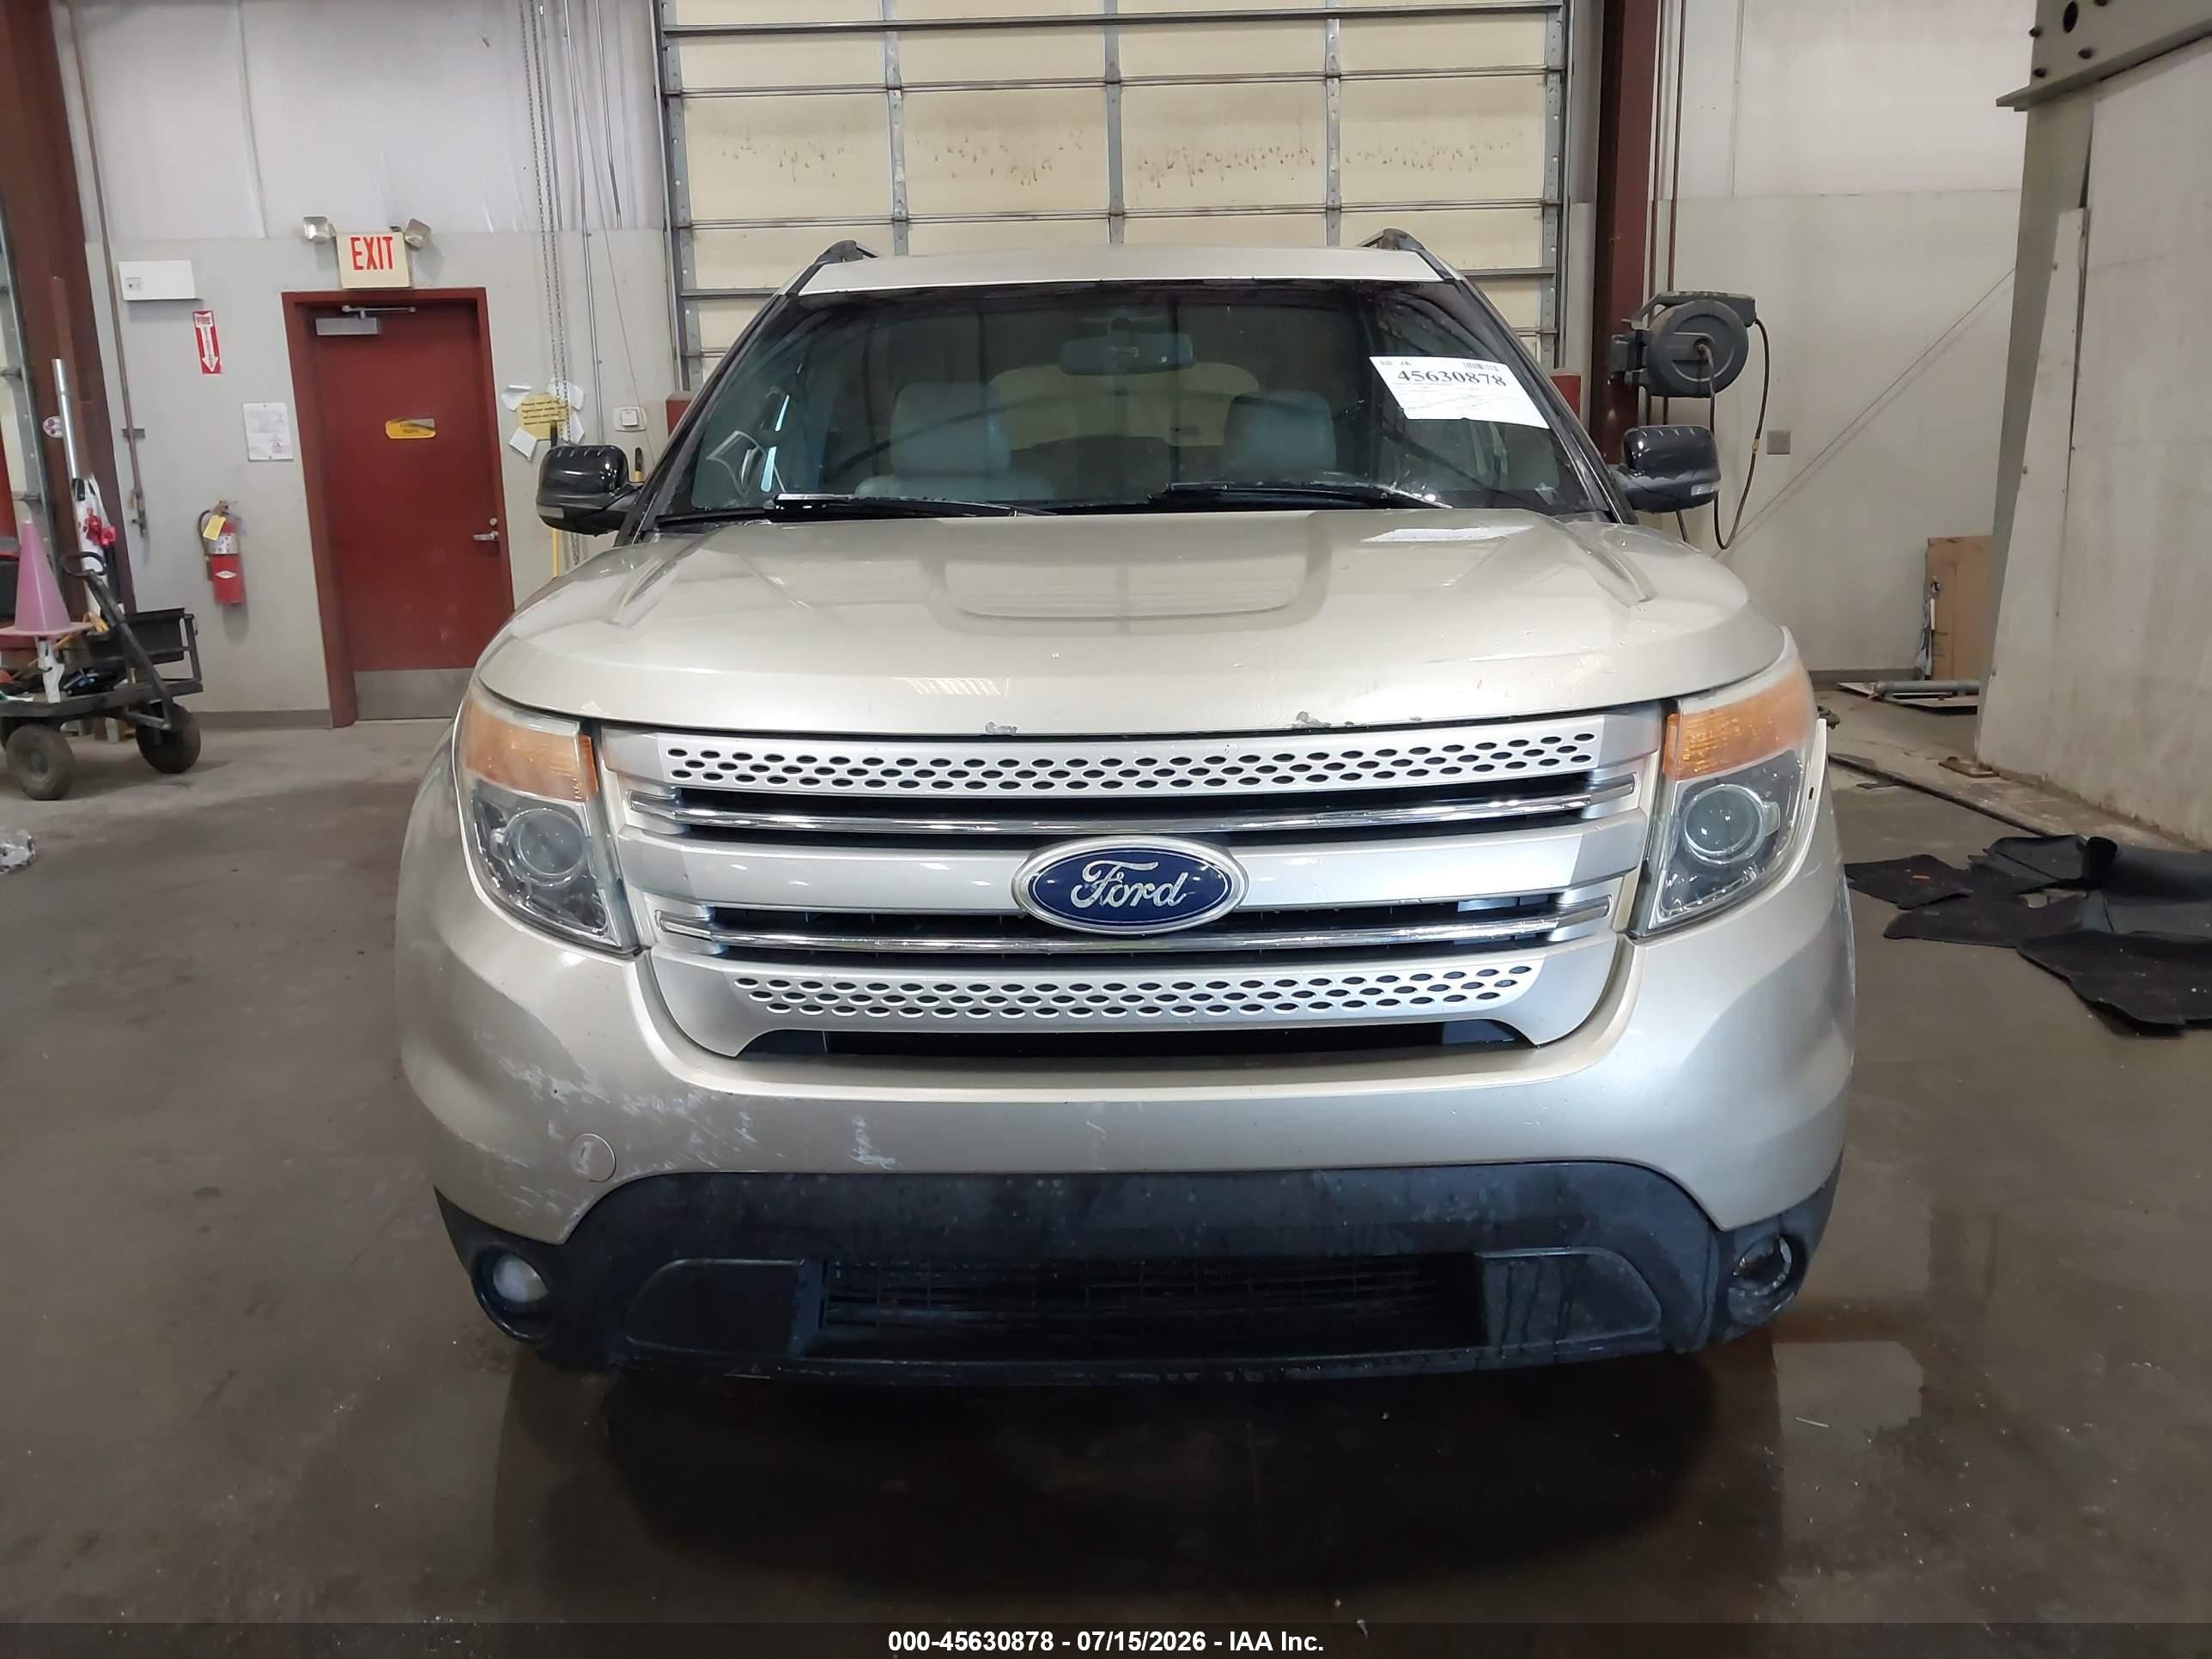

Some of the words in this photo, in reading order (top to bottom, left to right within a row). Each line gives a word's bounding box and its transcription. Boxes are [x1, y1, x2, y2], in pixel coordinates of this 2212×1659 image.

[350, 236, 393, 270] EXIT
[1398, 370, 1506, 386] 45630878
[1071, 860, 1192, 908] Ford
